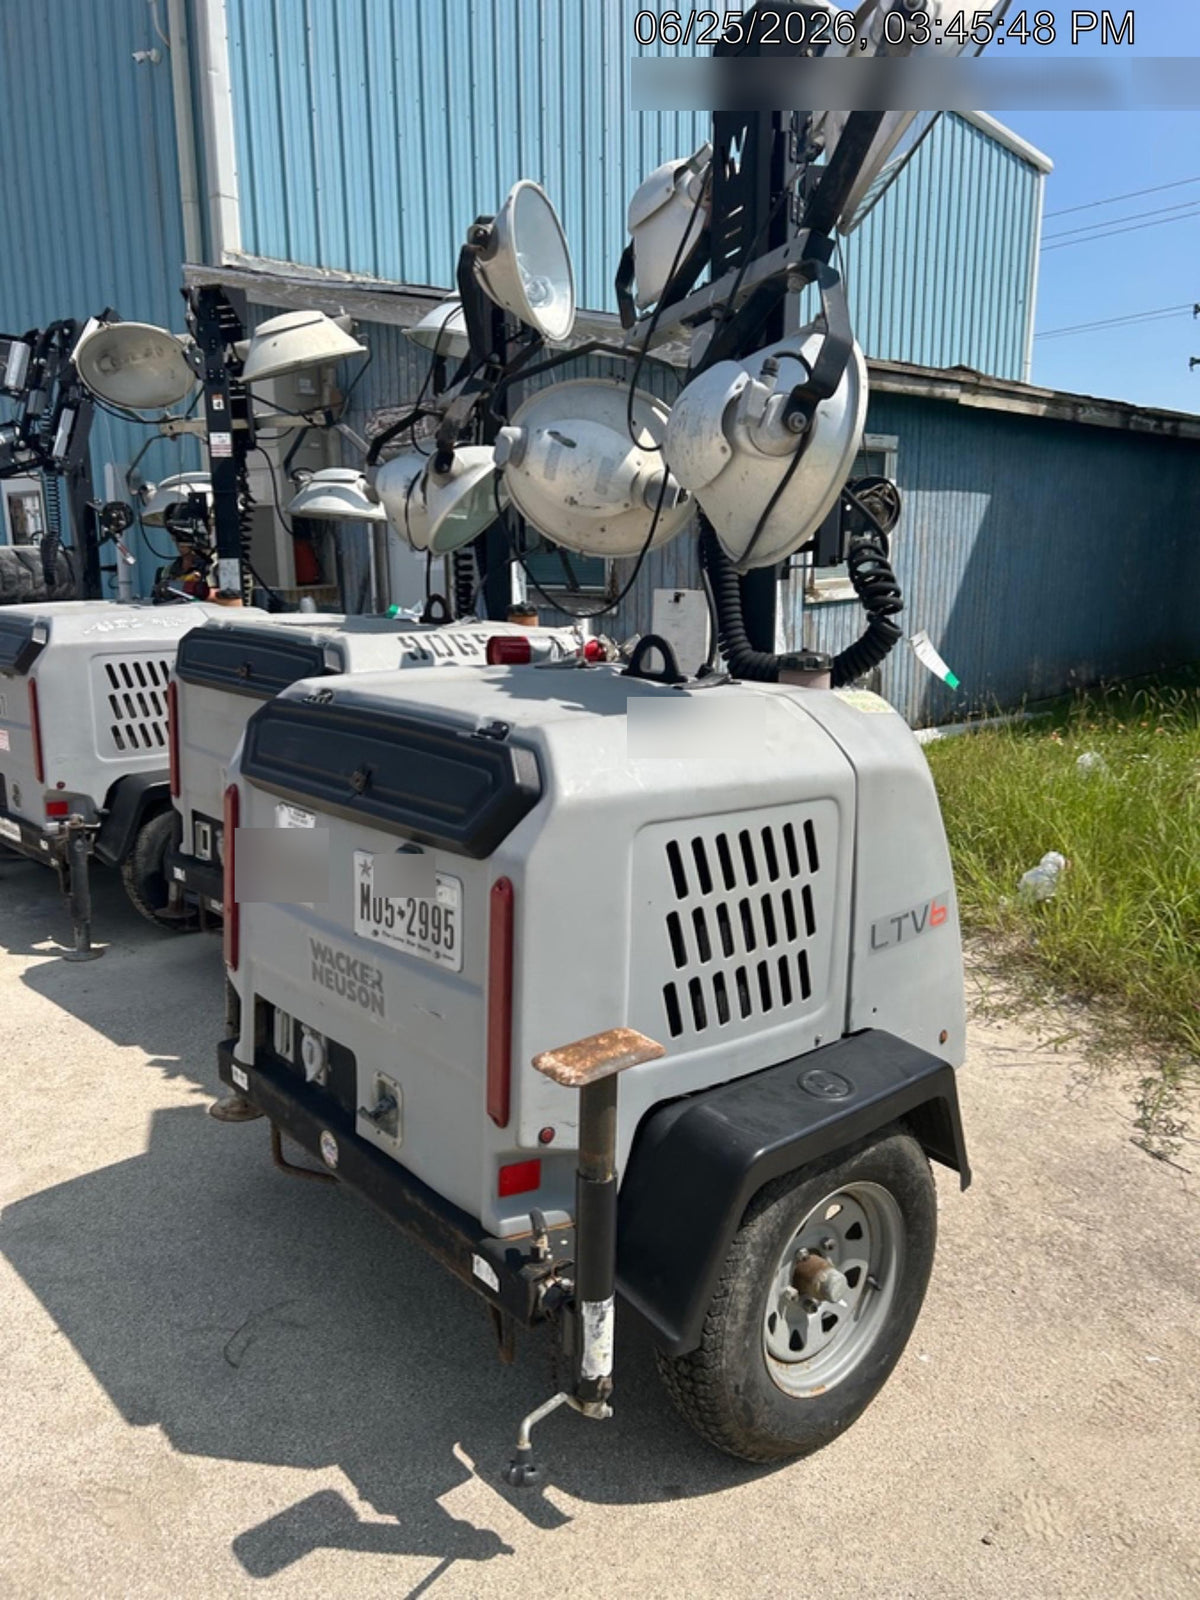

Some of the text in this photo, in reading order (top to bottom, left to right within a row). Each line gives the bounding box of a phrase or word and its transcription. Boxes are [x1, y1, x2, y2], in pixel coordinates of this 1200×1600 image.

[406, 897, 454, 950] 2995
[871, 898, 947, 950] LTV6
[309, 936, 384, 994] WACKER
[312, 961, 385, 1018] NEUSON
